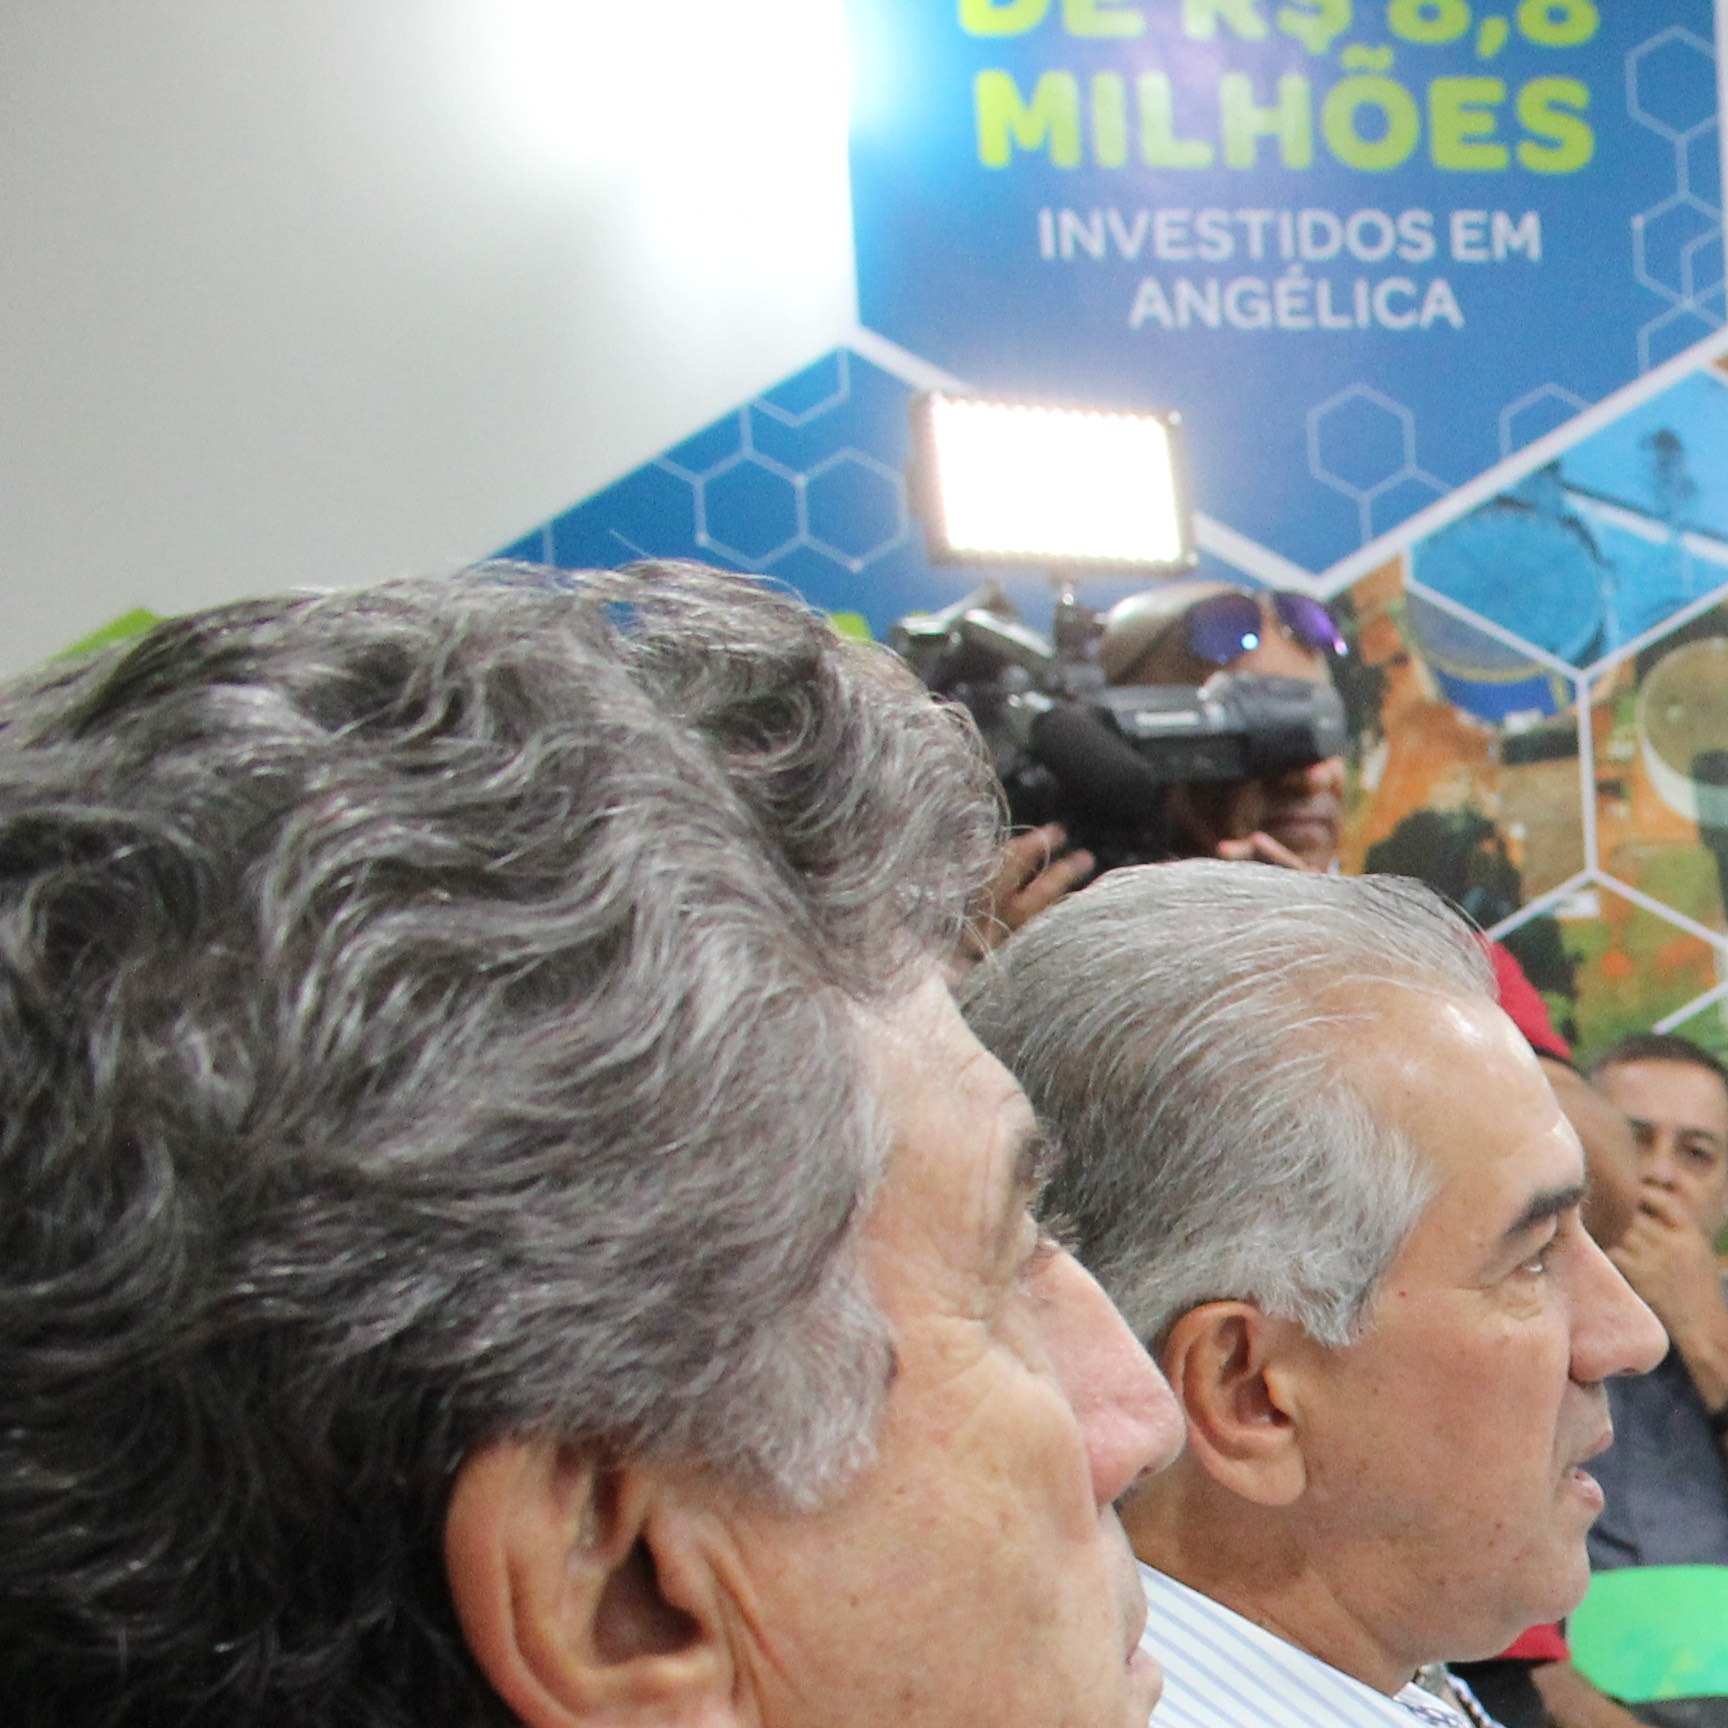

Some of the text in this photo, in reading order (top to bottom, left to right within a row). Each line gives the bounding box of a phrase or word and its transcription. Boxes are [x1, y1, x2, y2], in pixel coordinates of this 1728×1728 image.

[975, 46, 1595, 174] MILHÕES
[1037, 206, 1541, 262] INVESTIDOS EM
[1127, 264, 1465, 330] ANGÉLICA
